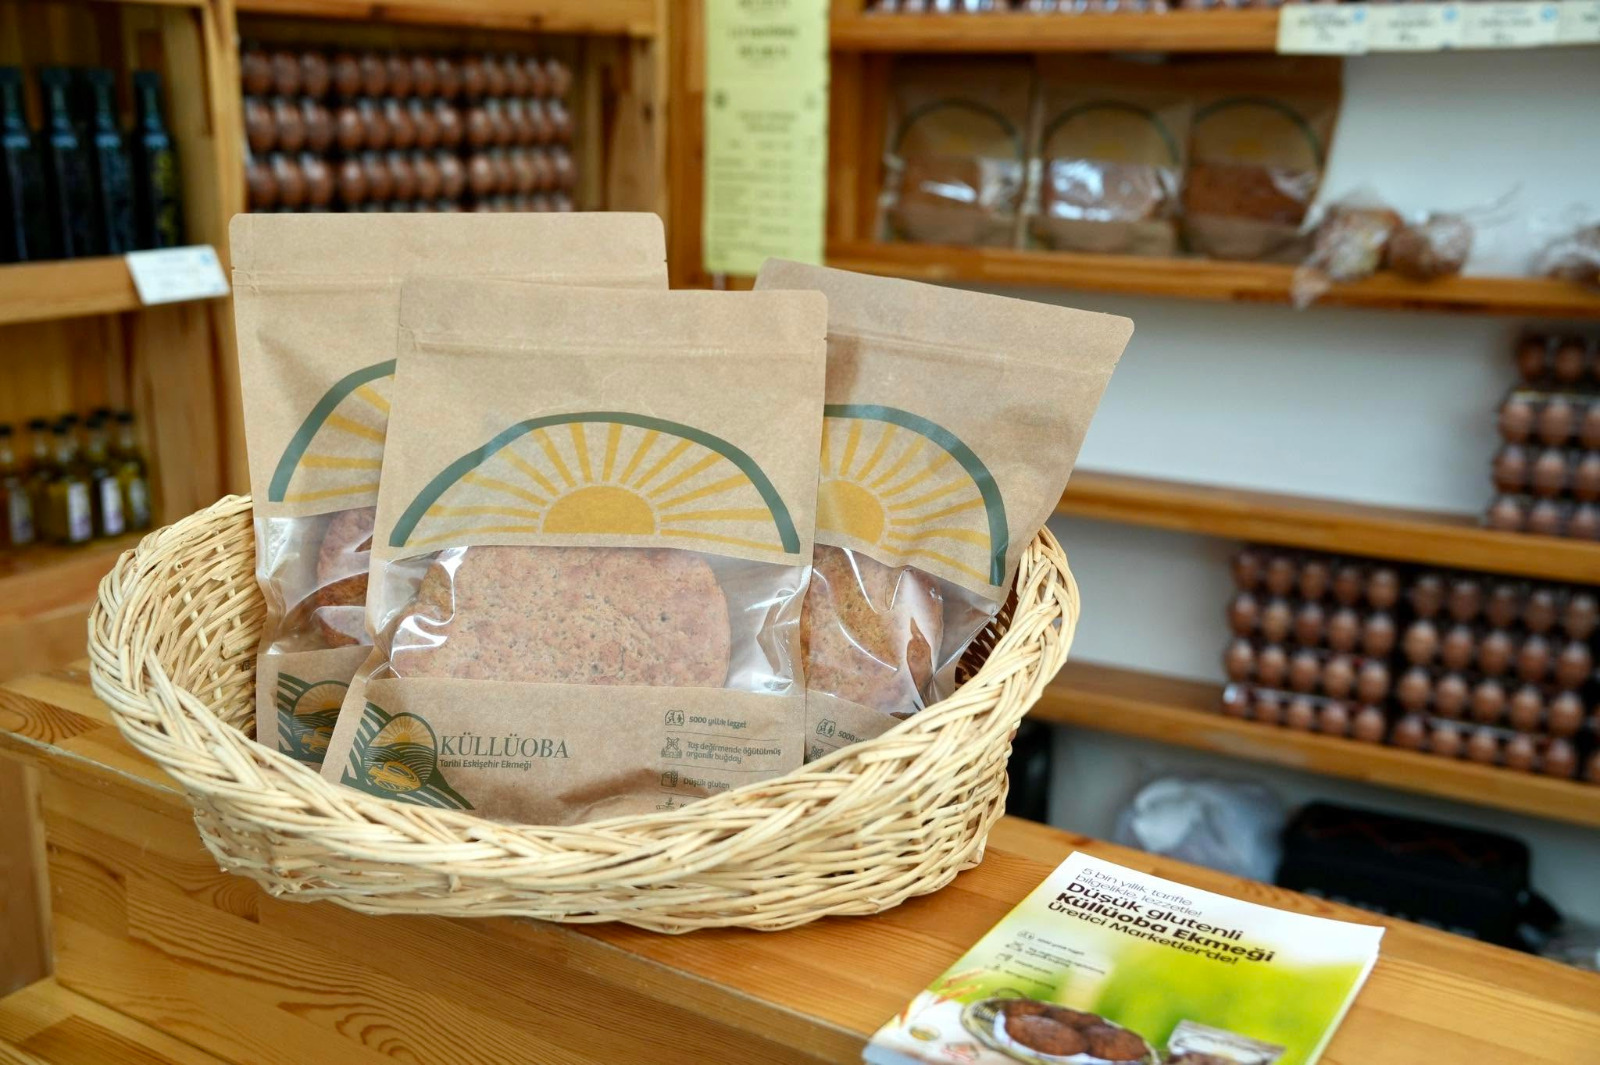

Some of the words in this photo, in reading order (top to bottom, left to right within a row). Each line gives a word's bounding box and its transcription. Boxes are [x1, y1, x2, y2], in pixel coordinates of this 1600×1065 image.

[689, 716, 707, 724] 5000
[440, 731, 570, 758] KÜLLÜOBA
[838, 730, 855, 742] 5000
[687, 741, 699, 751] Taş
[700, 742, 742, 754] değirmende
[743, 748, 781, 757] öğütülmüş
[715, 753, 742, 764] buğday
[440, 760, 461, 768] Tarihi
[463, 760, 499, 770] Eskişehir
[501, 760, 532, 771] Ekmeği
[683, 777, 706, 787] Düşük
[707, 780, 730, 789] gluten
[1075, 874, 1138, 900] bilgelikle,
[1141, 895, 1203, 917] lezzetle!
[1095, 872, 1117, 884] bin
[1120, 881, 1146, 894] yıllık
[1152, 890, 1193, 906] tarifle
[1066, 882, 1143, 912] Düşük
[1146, 909, 1244, 941] glutenli
[1048, 901, 1108, 926] Üretici
[1108, 922, 1239, 965] Marketler'de!
[1056, 892, 1168, 934] Küllüoba
[1172, 928, 1275, 962] Ekmeği
